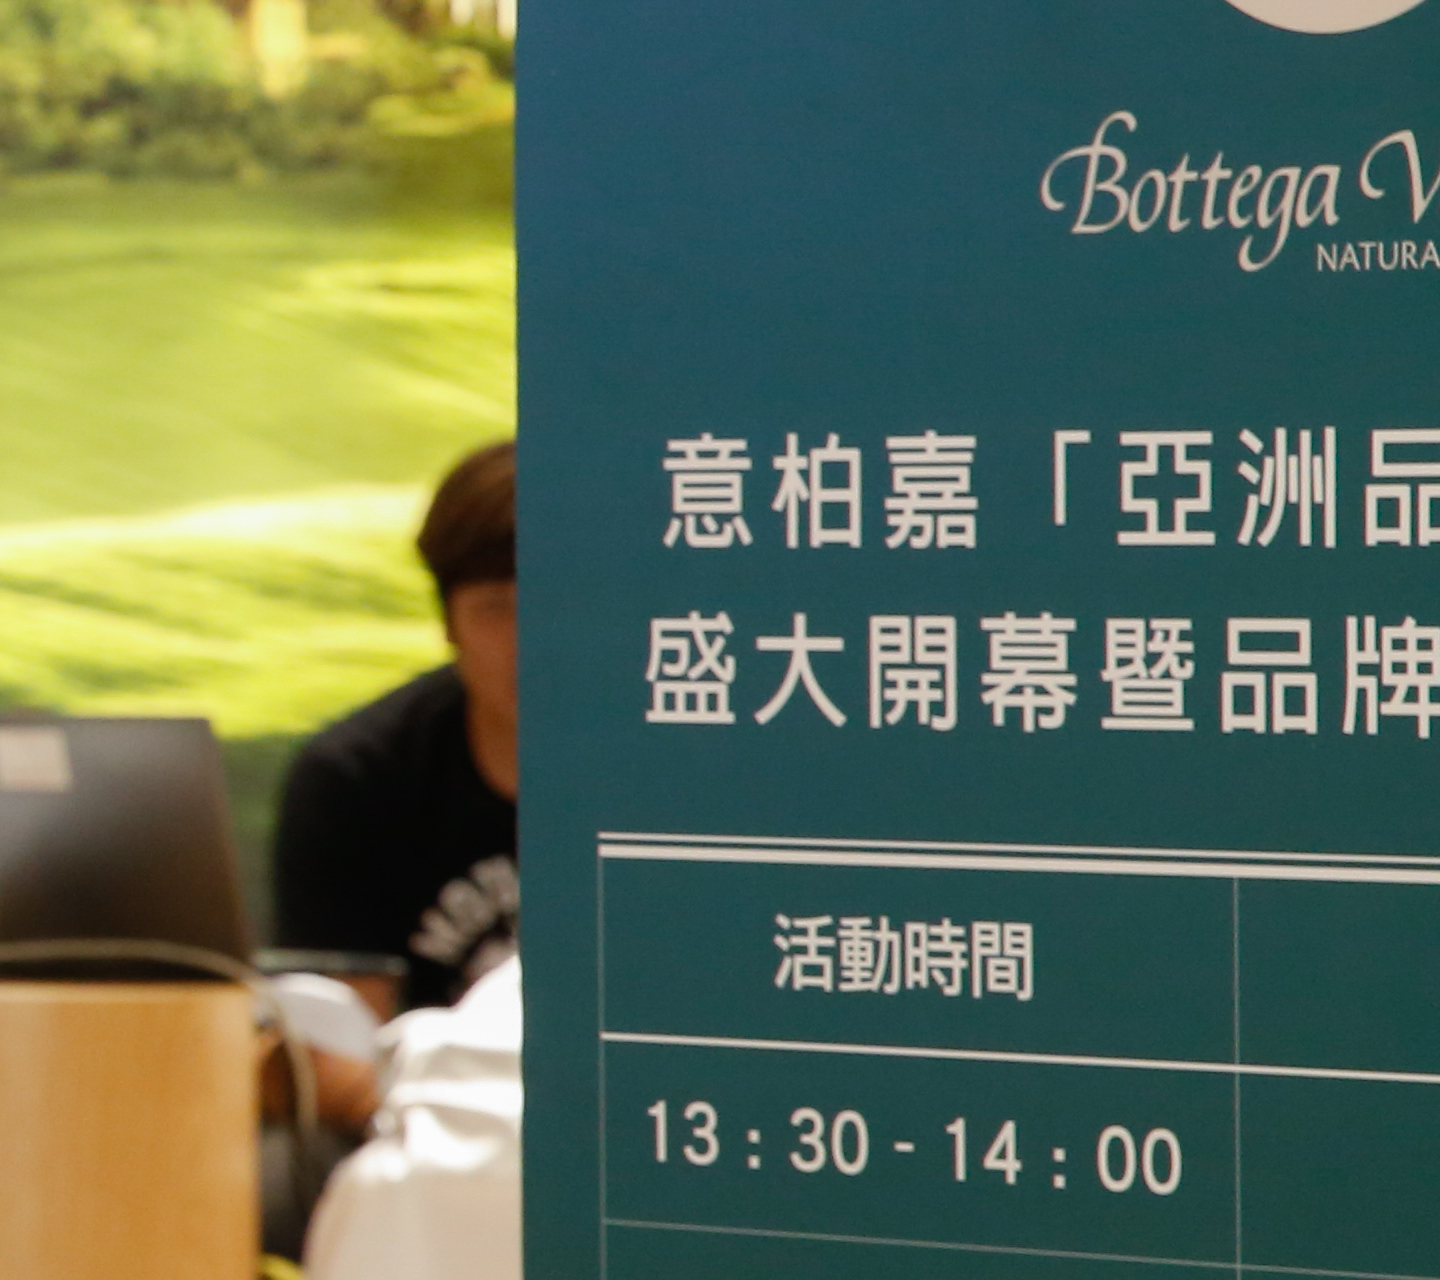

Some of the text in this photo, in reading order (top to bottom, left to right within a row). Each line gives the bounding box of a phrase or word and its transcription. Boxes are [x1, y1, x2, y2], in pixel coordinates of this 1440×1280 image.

[1040, 109, 1342, 273] Bottega
[1316, 240, 1440, 272] NATURA
[644, 610, 1440, 740] 盛大開幕暨品牌
[772, 913, 1034, 1002] 活動時間
